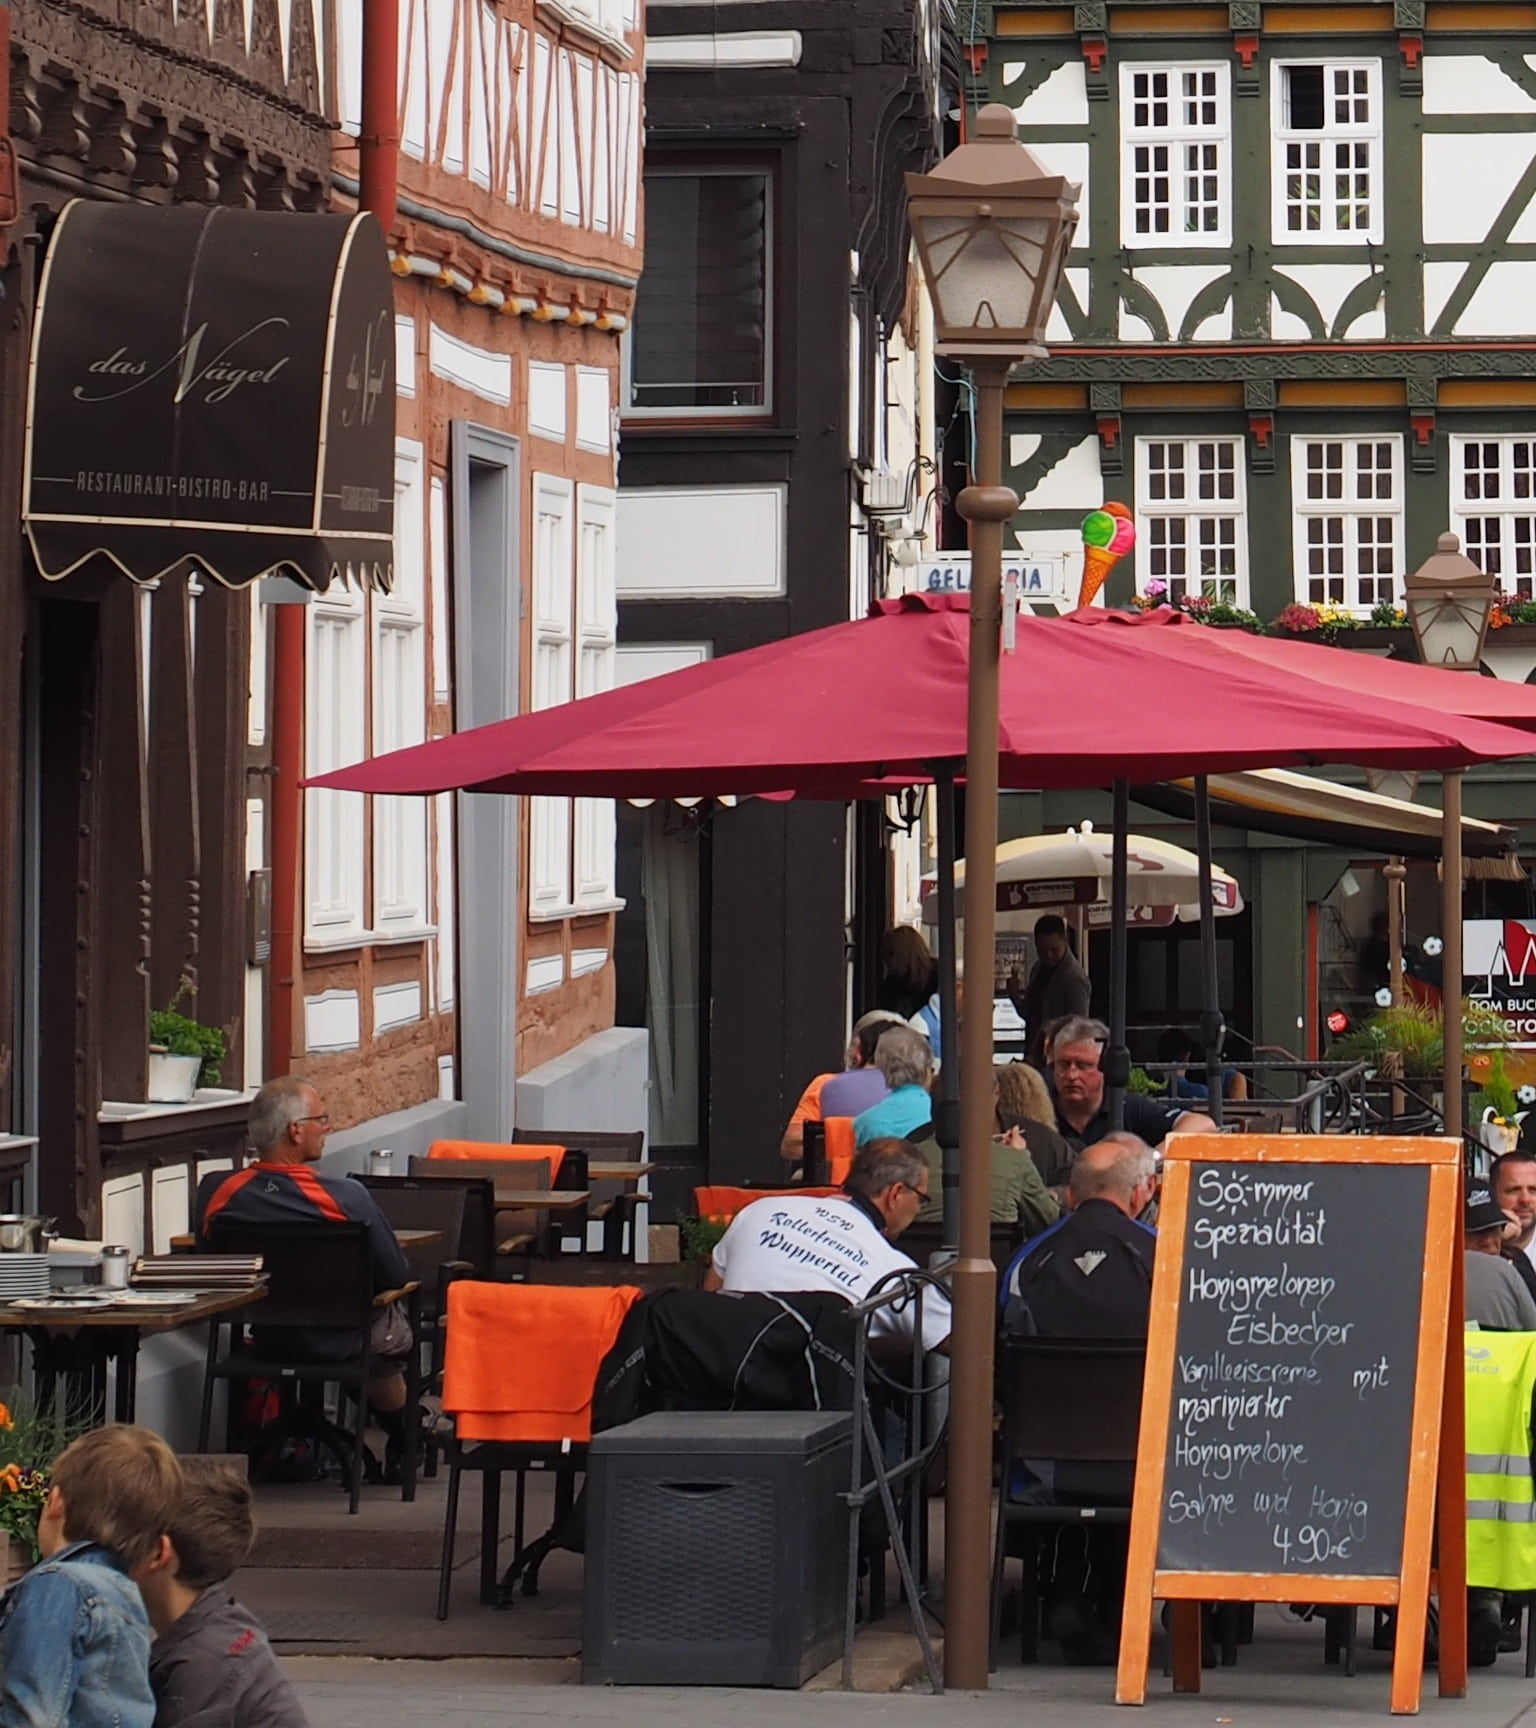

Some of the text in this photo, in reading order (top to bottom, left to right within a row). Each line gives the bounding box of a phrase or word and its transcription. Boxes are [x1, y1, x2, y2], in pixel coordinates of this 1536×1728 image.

[72, 316, 290, 404] Nägel
[88, 346, 148, 375] das
[1469, 1000, 1503, 1012] DOM
[759, 1229, 862, 1287] Wuppertal
[769, 1211, 870, 1267] Rollerfreunde
[1193, 1209, 1327, 1260] Spezialität
[1188, 1261, 1336, 1312] Honigmelonen
[1226, 1309, 1355, 1365] Eisbecher
[1352, 1355, 1390, 1401] mit
[1178, 1385, 1293, 1436] marinierter
[1174, 1429, 1309, 1481] Honigmelone
[1167, 1483, 1369, 1543] Sahne und Honig
